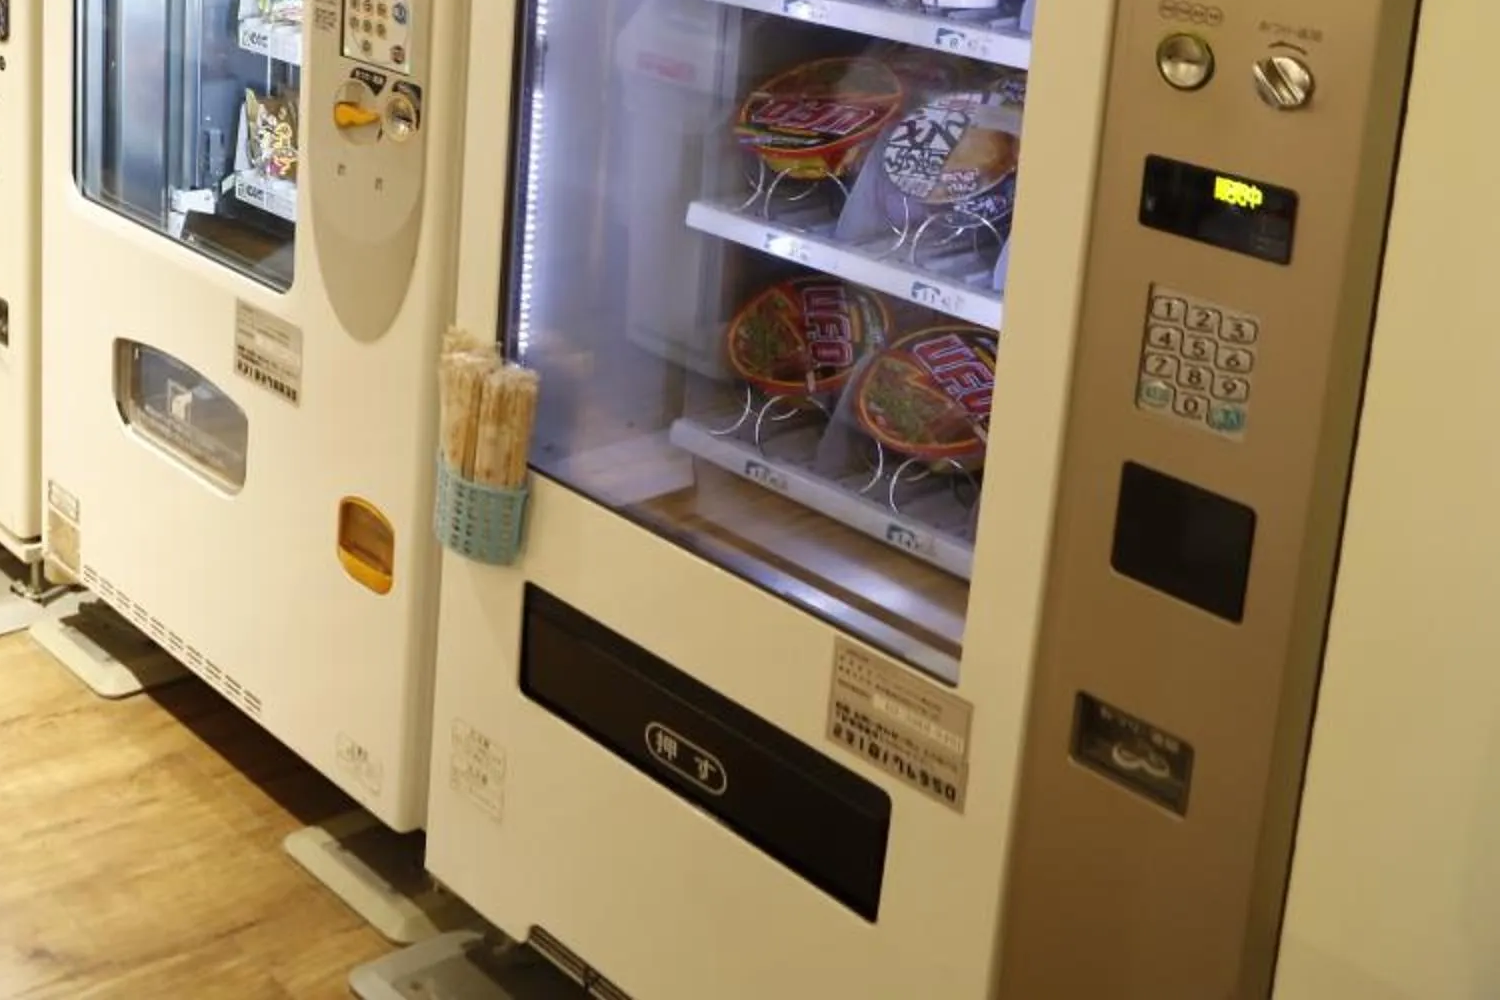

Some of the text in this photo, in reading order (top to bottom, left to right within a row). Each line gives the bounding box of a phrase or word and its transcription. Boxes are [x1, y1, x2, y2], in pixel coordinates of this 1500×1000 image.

[1196, 310, 1211, 328] 2
[1158, 331, 1172, 347] 4
[1230, 323, 1245, 340] 3
[1192, 340, 1206, 357] 5
[1155, 356, 1168, 374] 7
[1225, 354, 1241, 368] 6
[1187, 369, 1201, 385] 8
[1221, 379, 1238, 395] 9
[1183, 397, 1199, 414] 0
